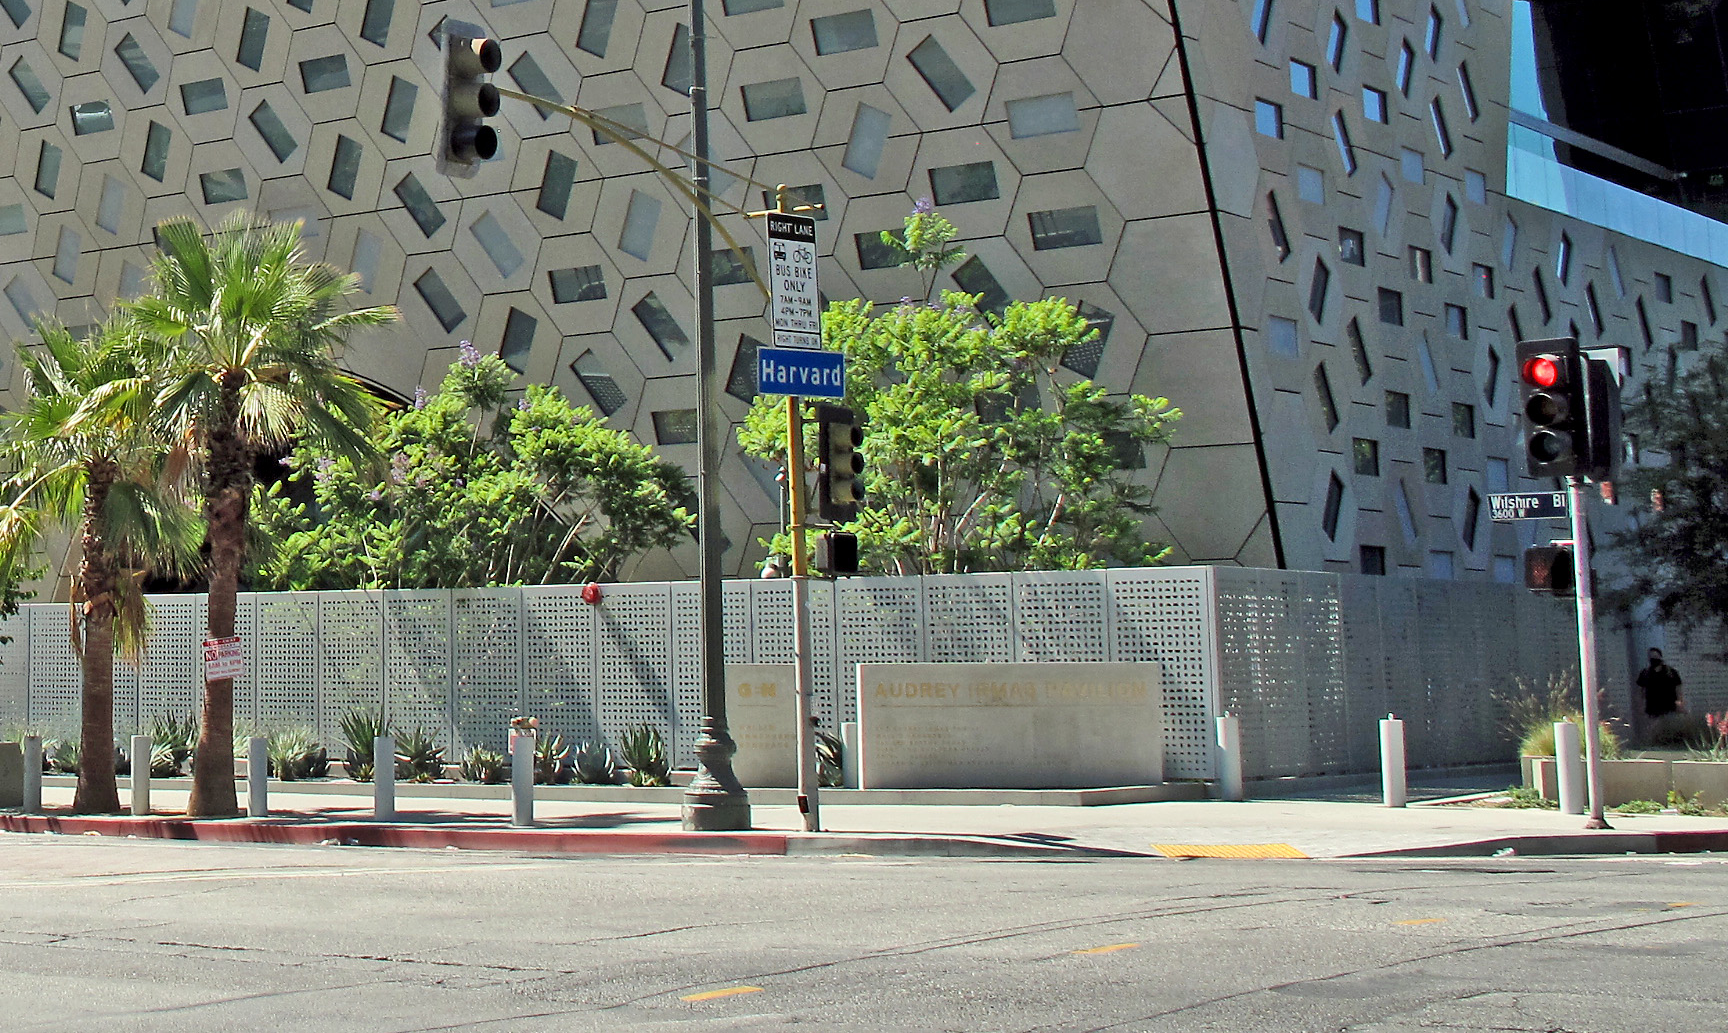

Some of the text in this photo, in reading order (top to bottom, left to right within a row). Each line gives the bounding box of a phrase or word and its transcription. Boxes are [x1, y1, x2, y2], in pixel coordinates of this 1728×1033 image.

[770, 220, 813, 236] RIGHT LANE
[775, 264, 812, 280] BUS BIKE
[783, 279, 806, 293] ONLY
[761, 359, 841, 386] Harvard
[1490, 495, 1540, 509] Wilshire
[1492, 508, 1525, 519] 3600 W
[205, 650, 217, 662] NO
[875, 682, 960, 698] AUDREY
